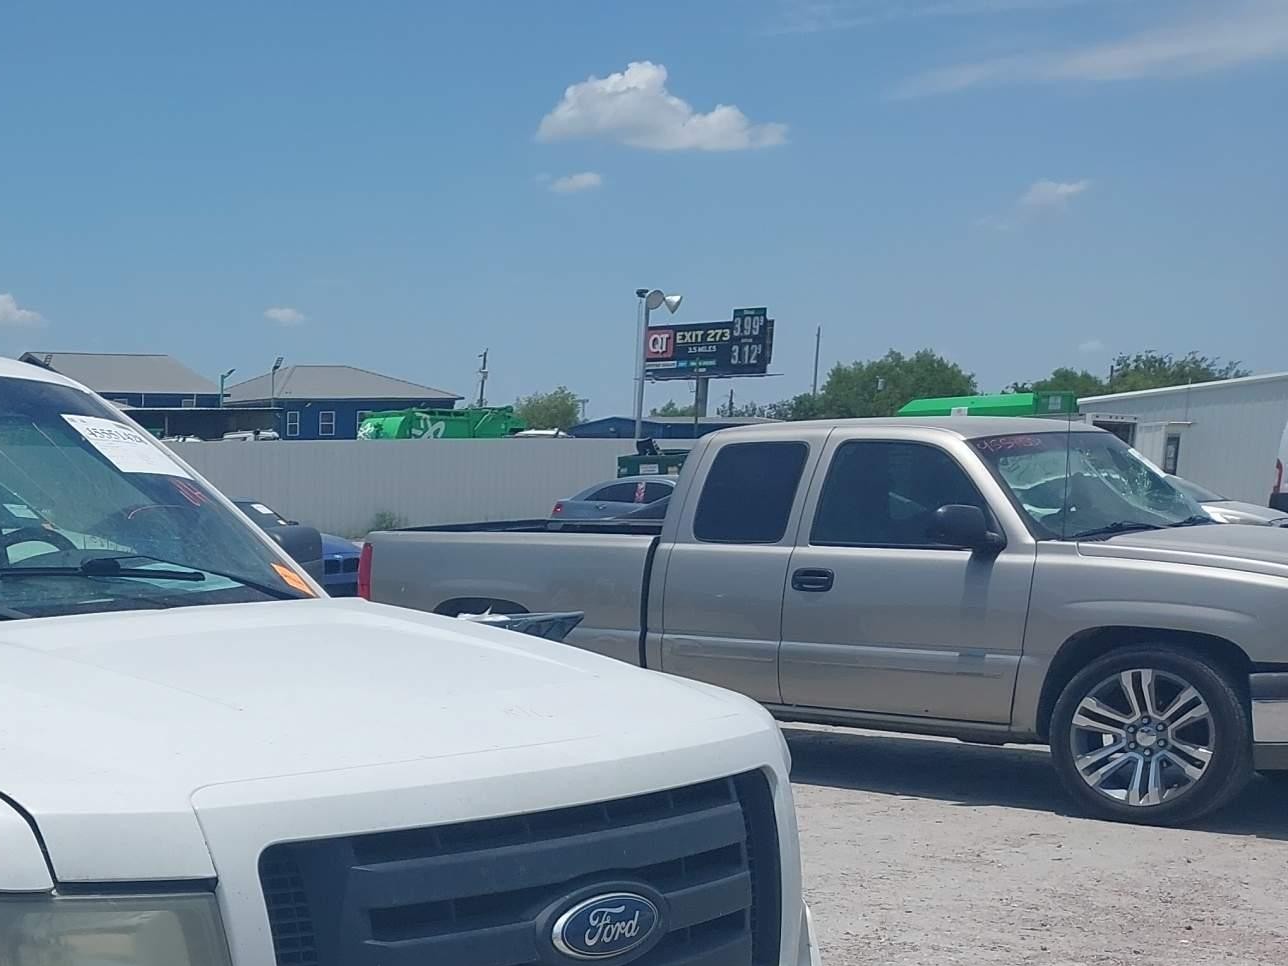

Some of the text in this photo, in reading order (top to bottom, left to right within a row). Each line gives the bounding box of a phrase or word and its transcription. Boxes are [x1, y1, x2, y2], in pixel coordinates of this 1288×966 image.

[649, 333, 670, 354] QT
[676, 328, 730, 343] EXIT 273
[584, 904, 640, 946] Ford
